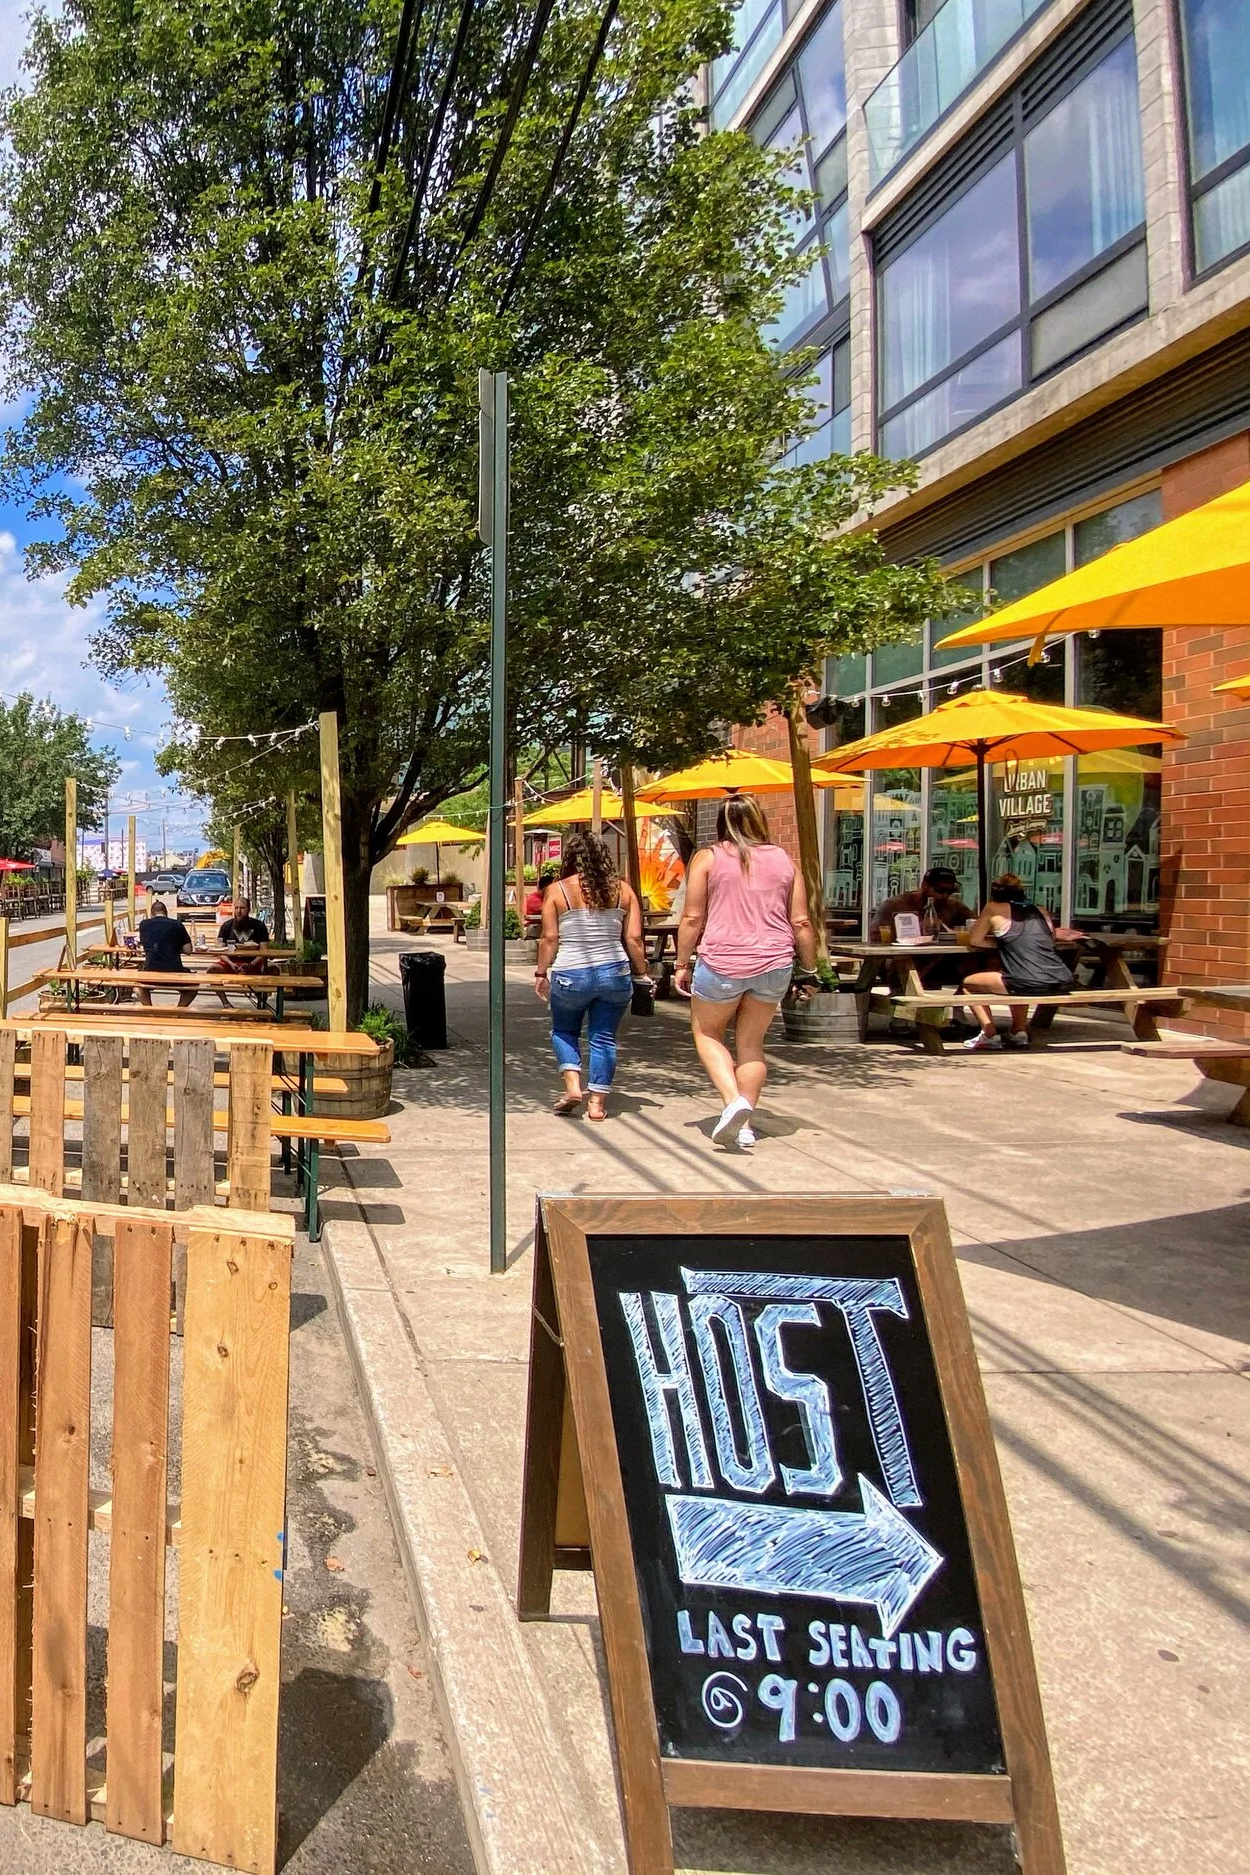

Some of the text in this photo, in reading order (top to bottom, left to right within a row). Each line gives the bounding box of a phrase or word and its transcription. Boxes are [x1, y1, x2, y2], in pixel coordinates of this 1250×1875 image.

[999, 793, 1052, 817] VILLAGE
[619, 1265, 923, 1507] HOST
[676, 1609, 976, 1672] LAST SEATING
[757, 1673, 901, 1743] 9:00
